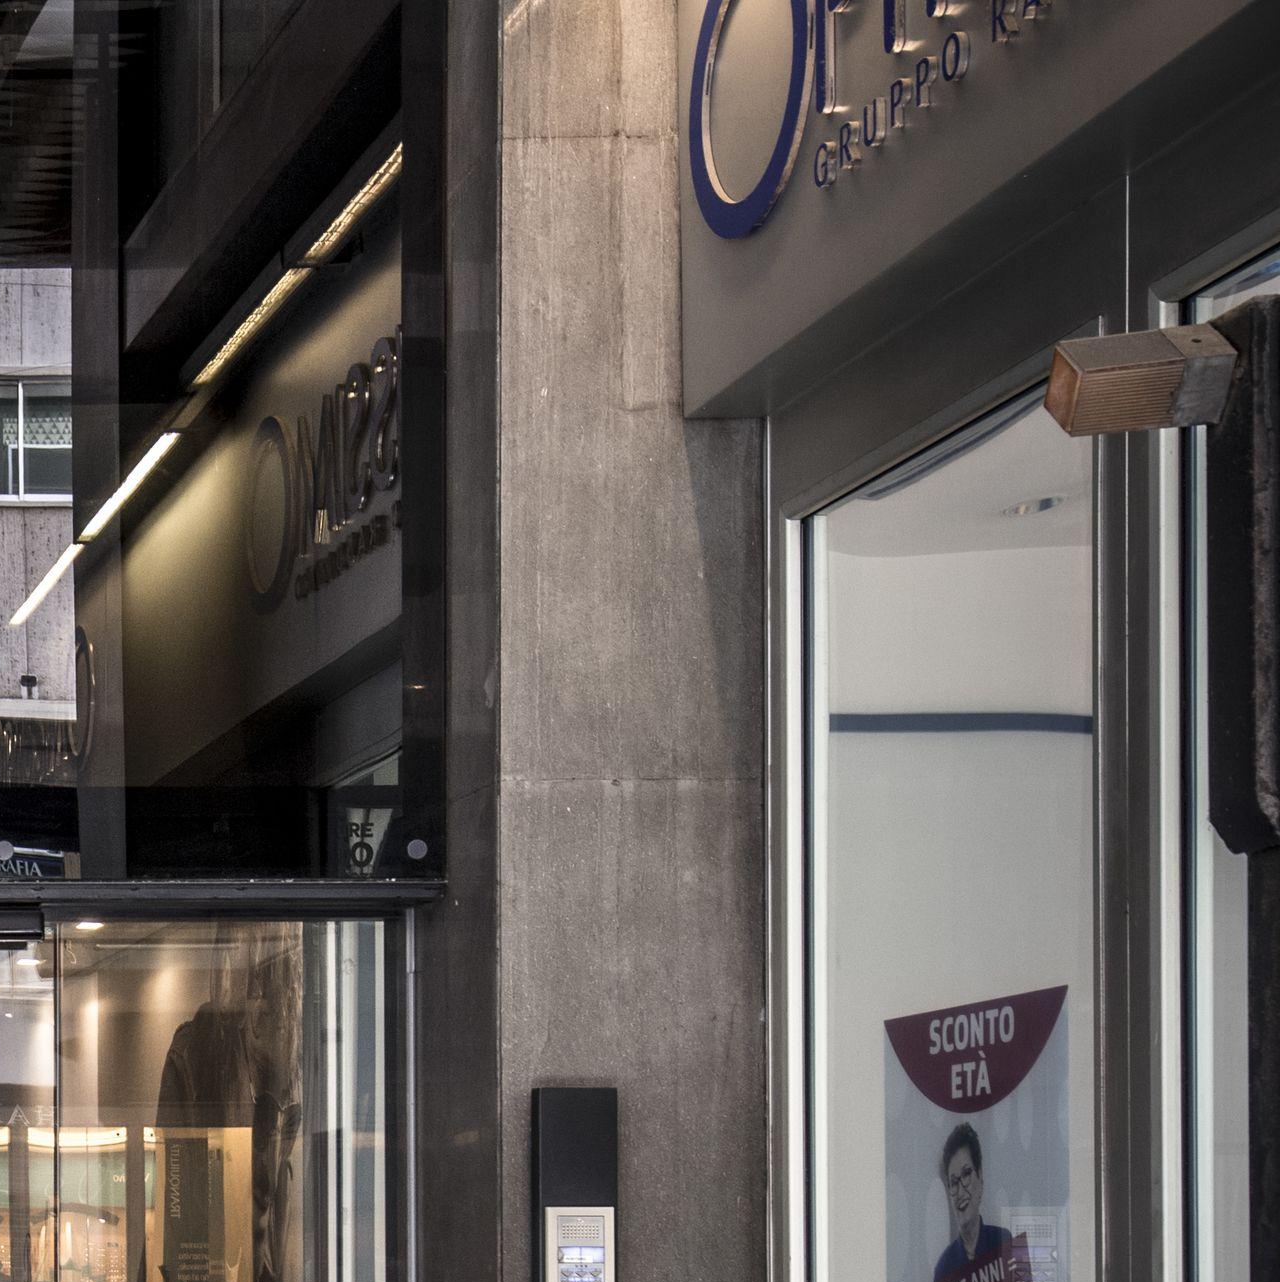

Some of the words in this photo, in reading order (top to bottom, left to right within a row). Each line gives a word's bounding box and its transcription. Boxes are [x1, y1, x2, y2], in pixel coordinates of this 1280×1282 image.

[814, 31, 970, 188] GRUPPO
[928, 1005, 1016, 1056] SCONTO
[950, 1050, 992, 1100] ETÀ
